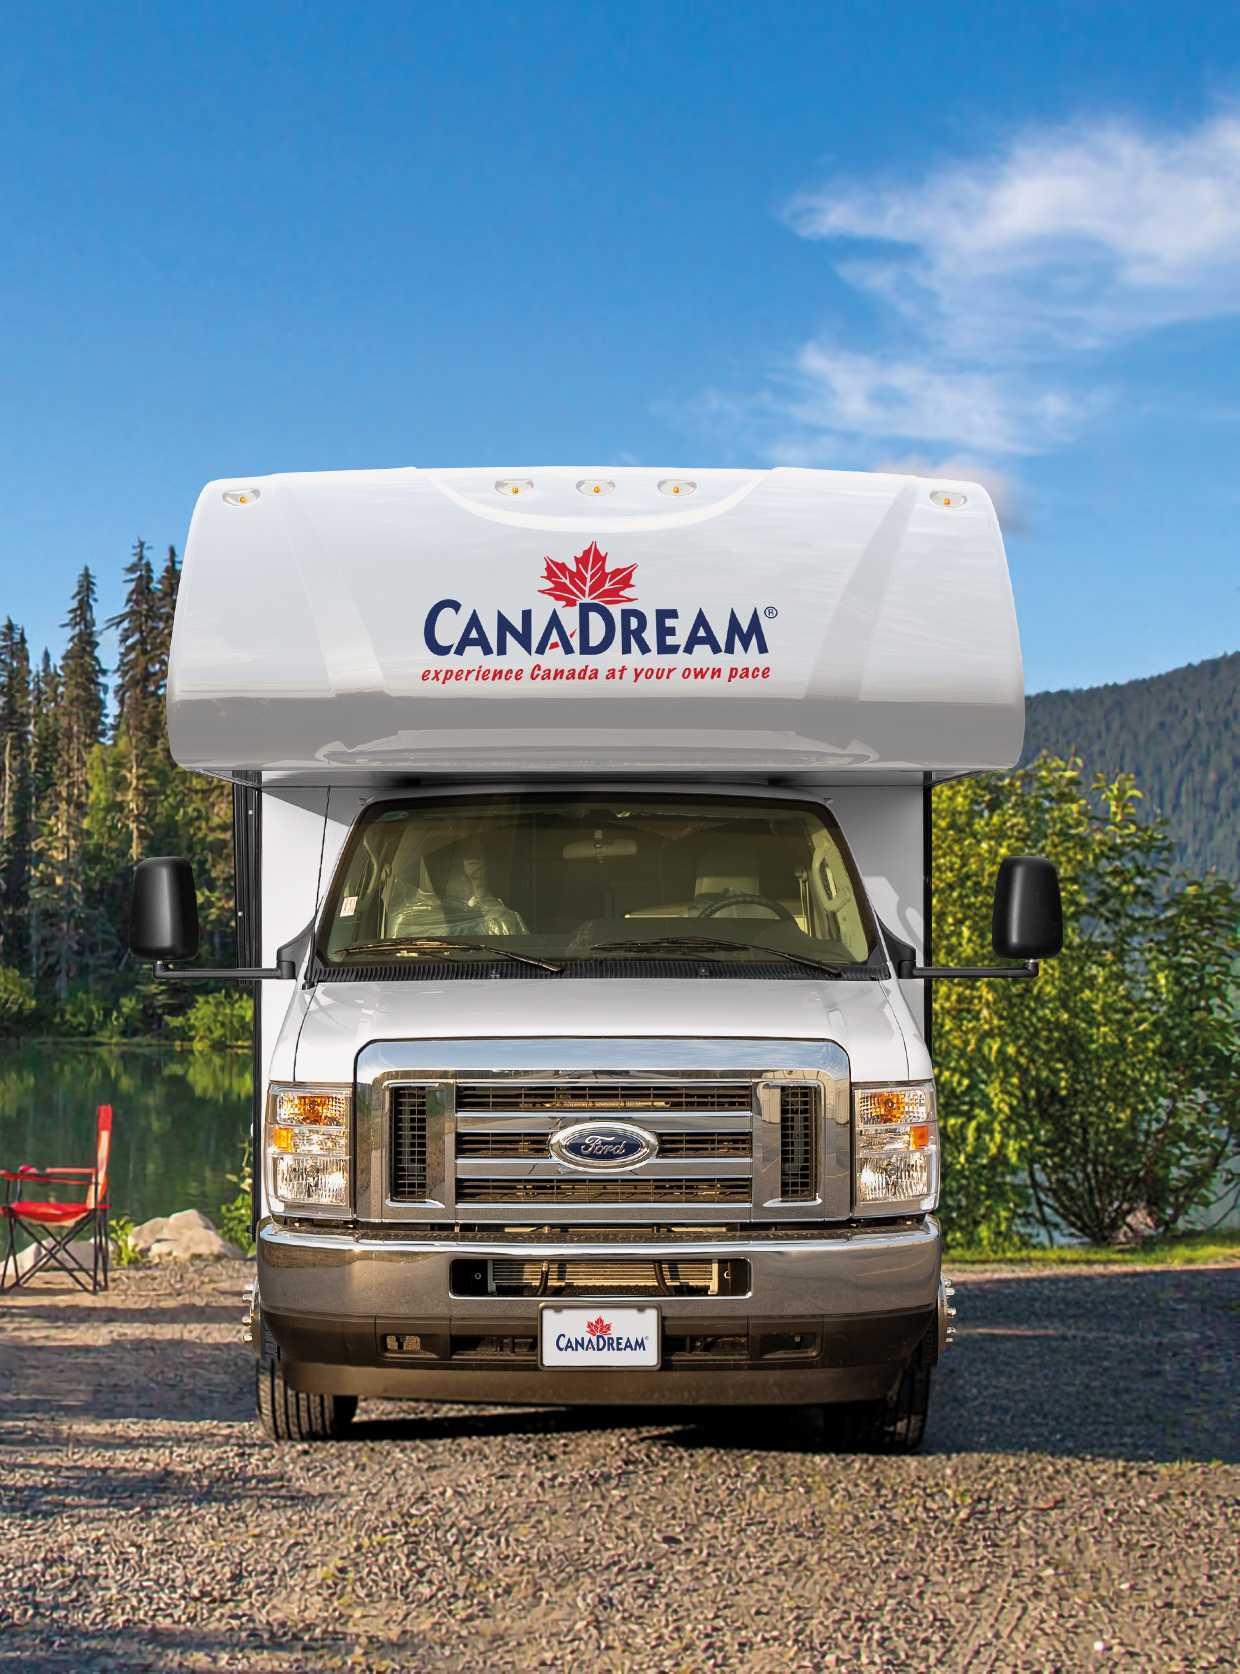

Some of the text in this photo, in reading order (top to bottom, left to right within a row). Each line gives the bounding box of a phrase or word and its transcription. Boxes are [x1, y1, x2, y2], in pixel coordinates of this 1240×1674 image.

[421, 664, 771, 684] experience Canada at your own pace
[581, 1136, 626, 1155] Ford
